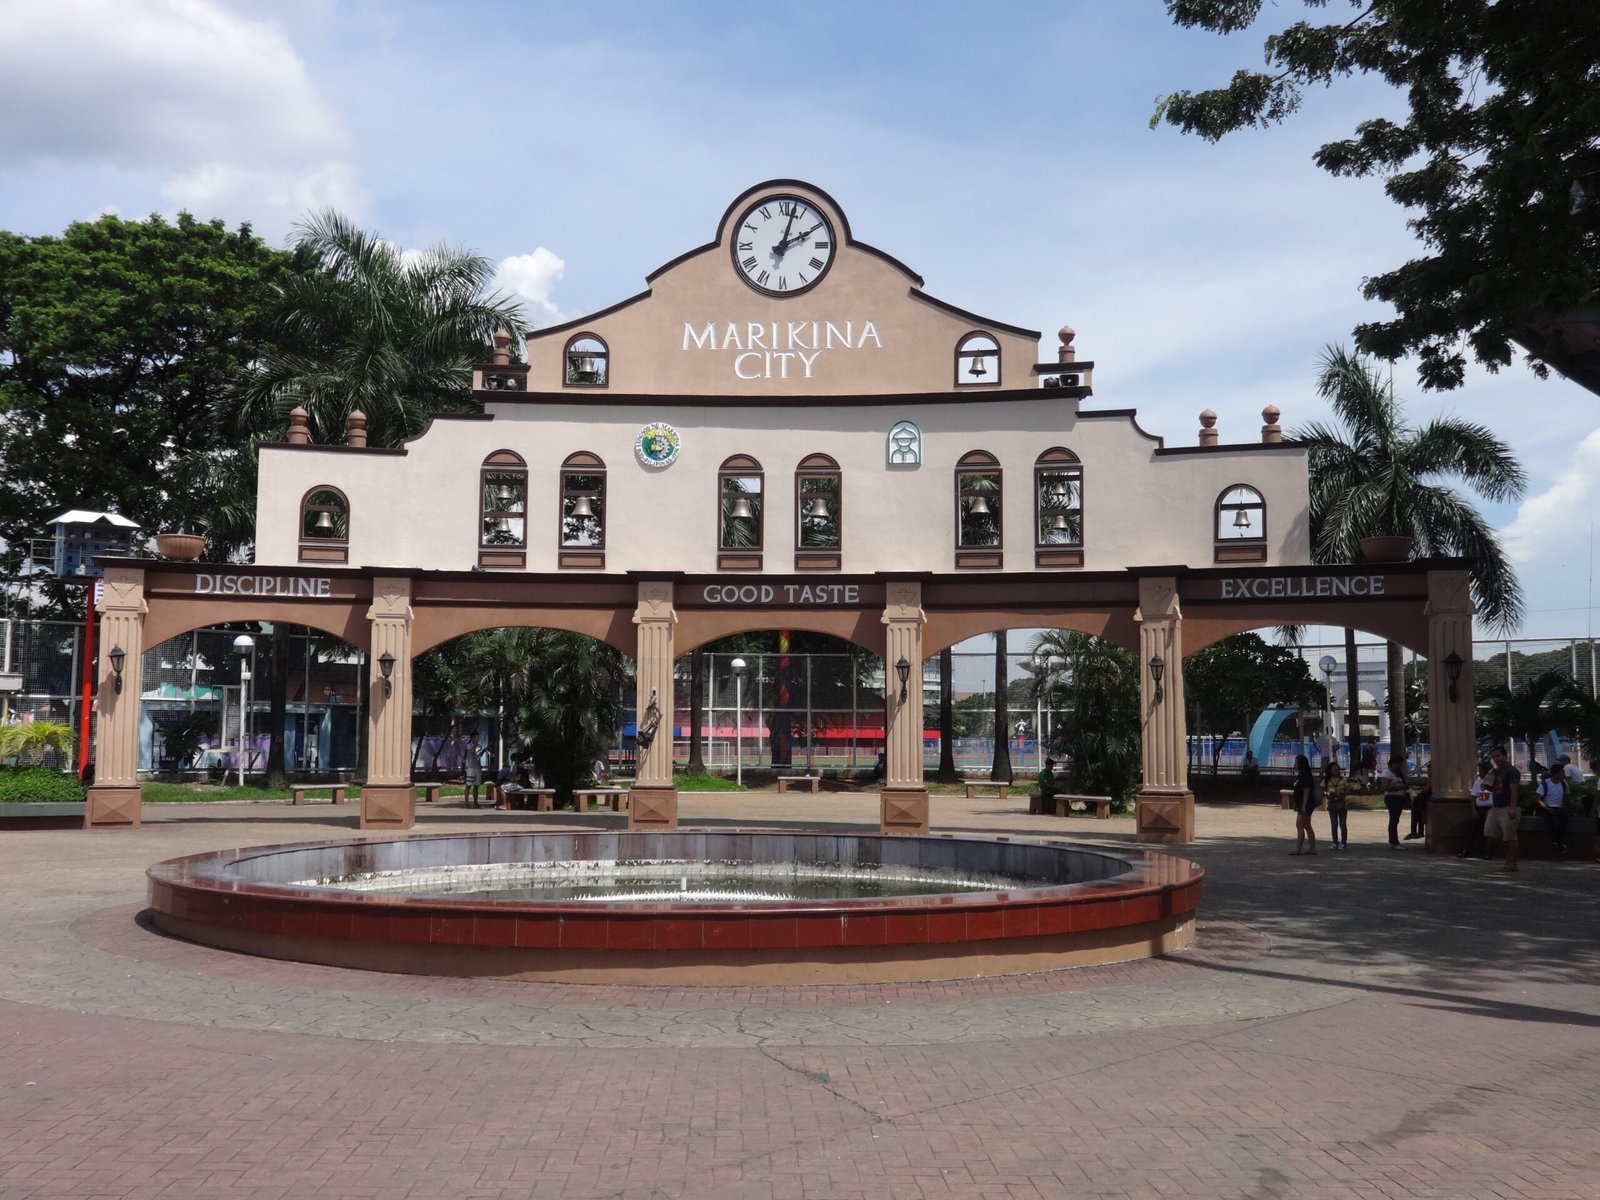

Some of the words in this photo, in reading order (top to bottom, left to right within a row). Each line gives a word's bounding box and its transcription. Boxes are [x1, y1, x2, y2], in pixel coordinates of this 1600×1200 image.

[758, 206, 772, 221] XI
[744, 222, 758, 233] X
[739, 242, 752, 250] IX
[681, 320, 884, 351] MARIKINA
[734, 350, 823, 379] CITY
[194, 573, 331, 597] DISCIPLINE
[703, 585, 774, 603] GOOD
[783, 584, 860, 604] TASTE
[1220, 575, 1385, 598] EXCELLENCE
